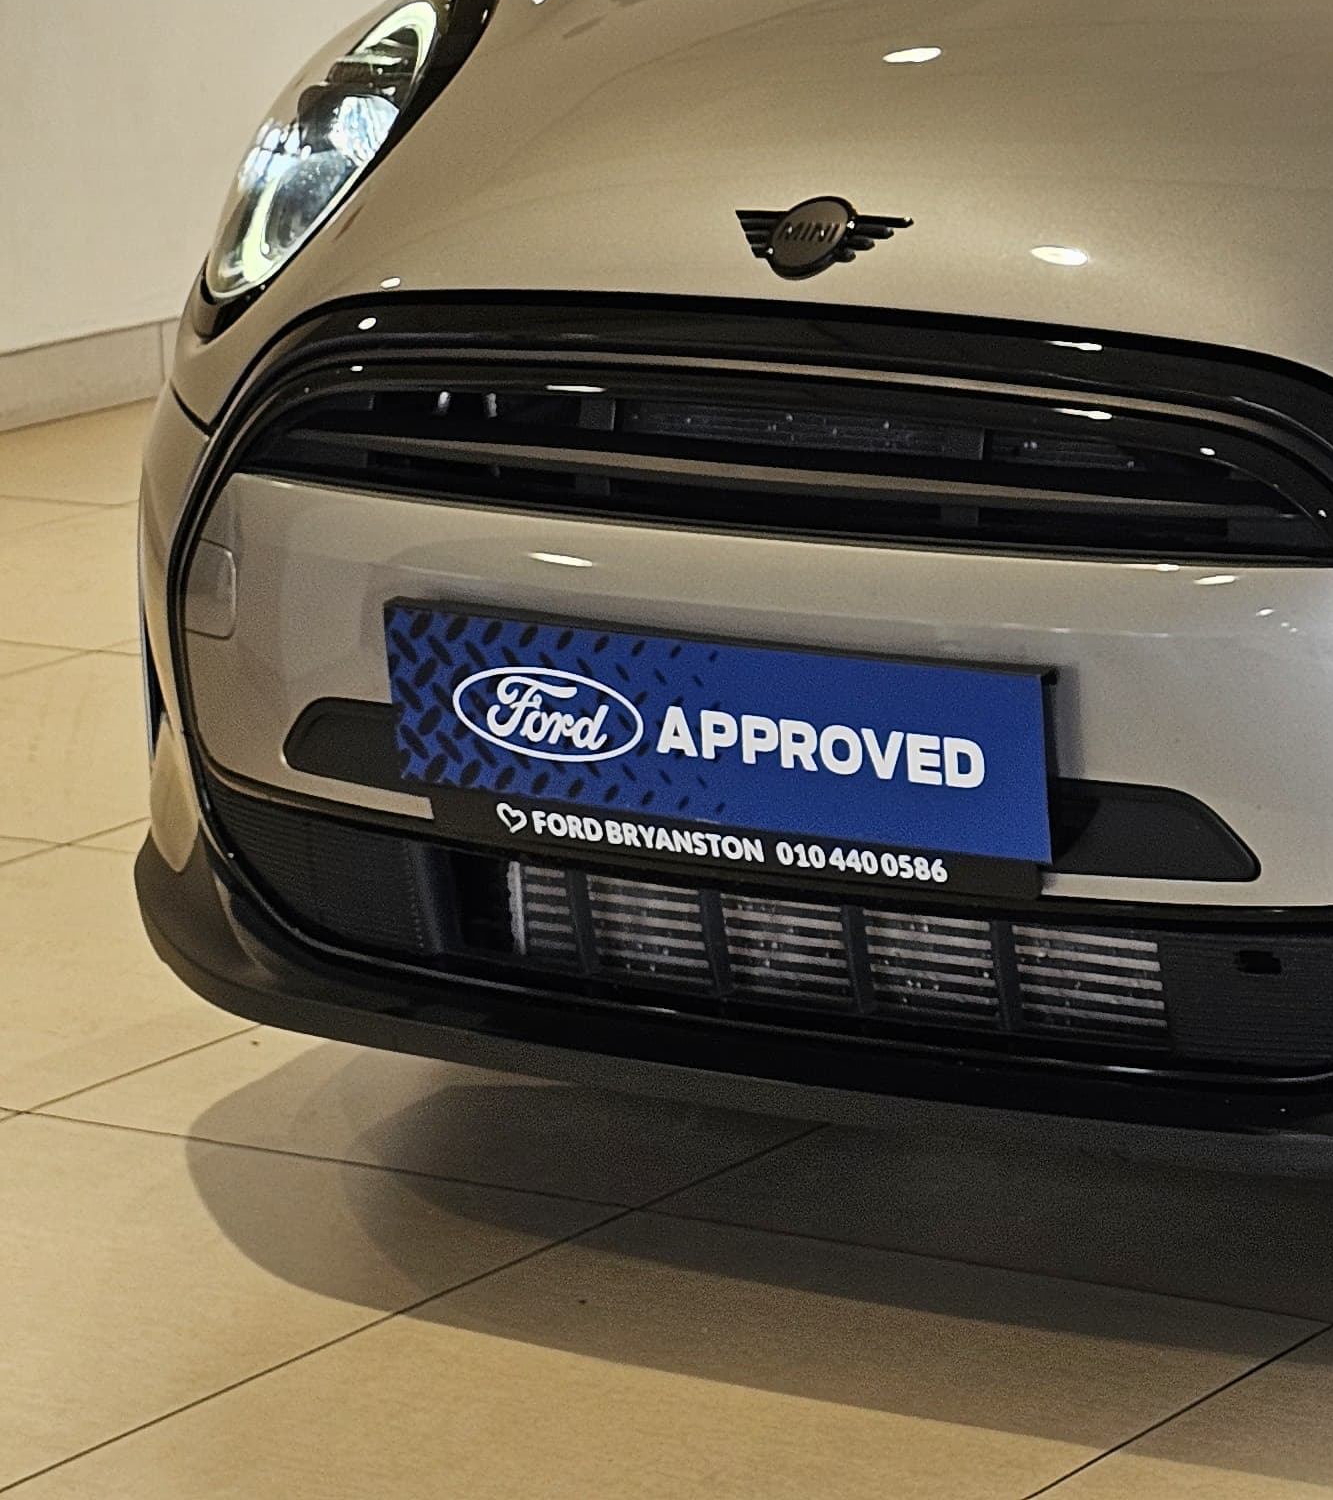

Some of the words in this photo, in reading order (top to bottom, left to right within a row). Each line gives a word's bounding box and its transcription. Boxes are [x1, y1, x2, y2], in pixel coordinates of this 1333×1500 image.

[776, 221, 842, 243] MINI
[486, 674, 609, 751] Ford
[656, 705, 986, 789] APPROVED
[532, 810, 602, 843] FORD
[605, 819, 765, 864] BRYANSTON
[776, 842, 826, 869] 010
[829, 847, 879, 876] 440
[879, 853, 948, 884] 0586
